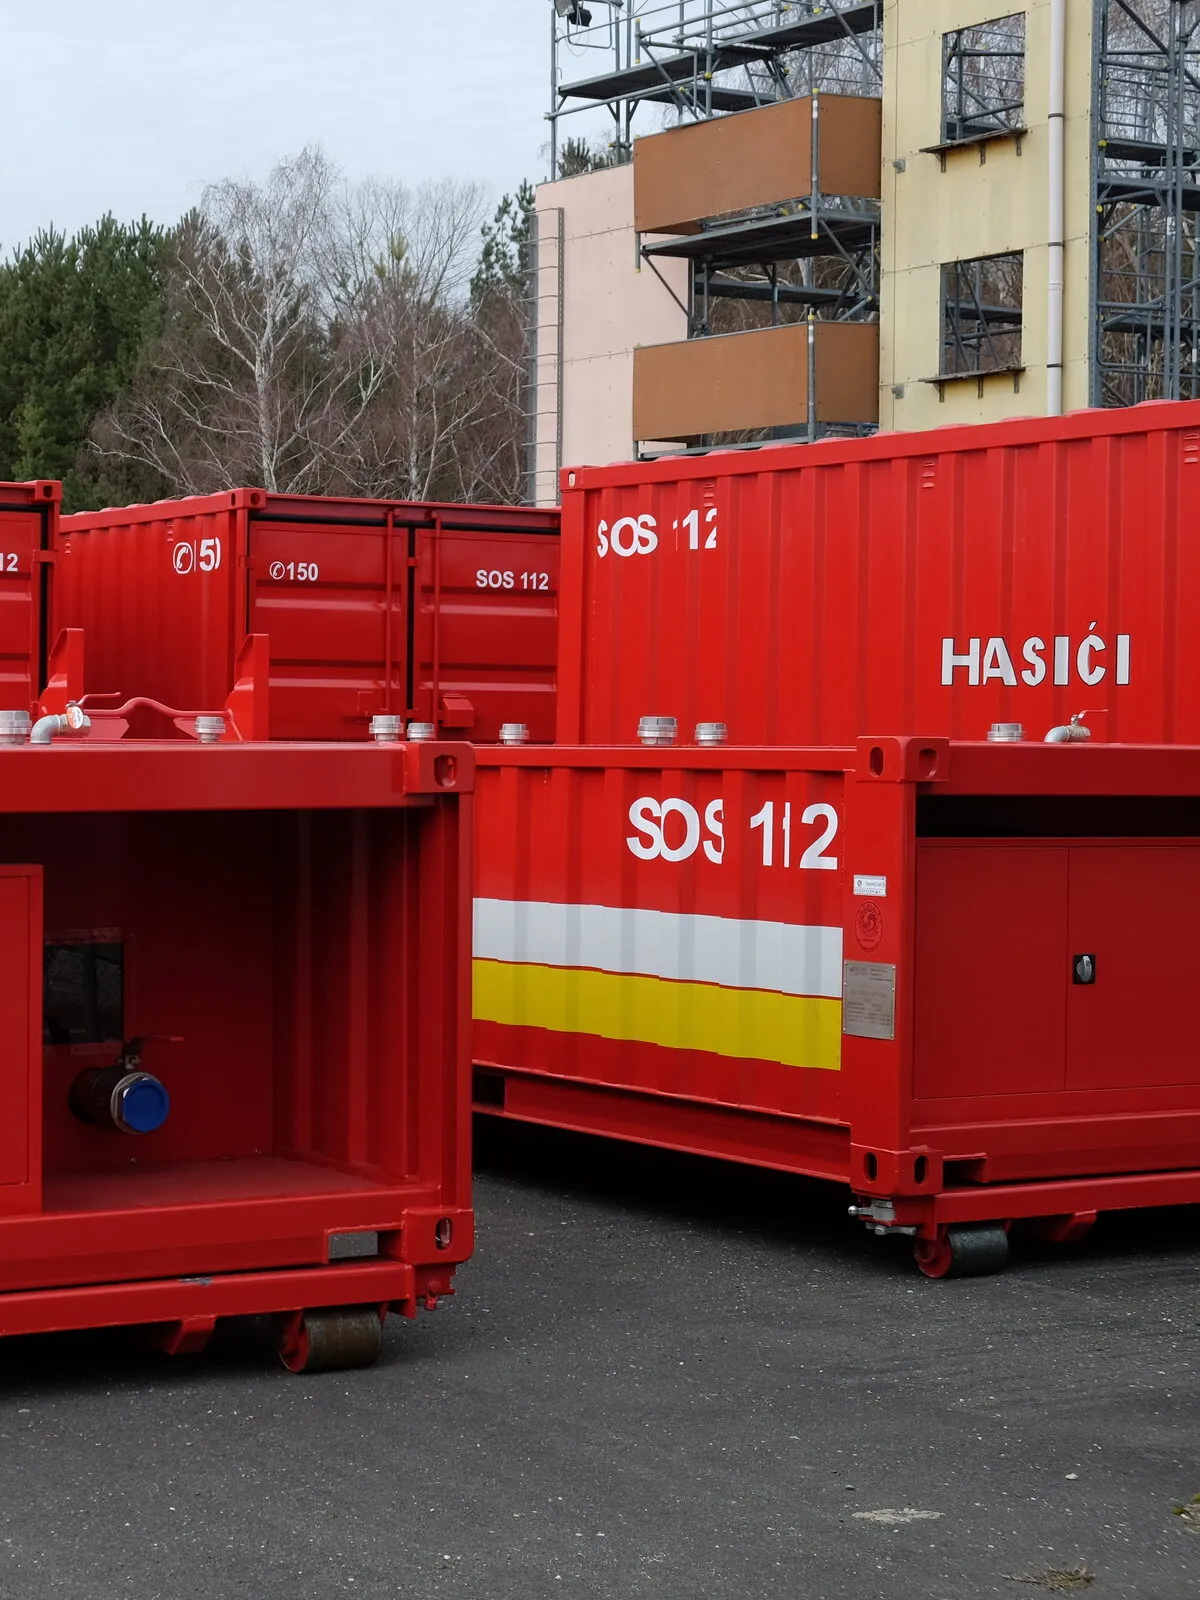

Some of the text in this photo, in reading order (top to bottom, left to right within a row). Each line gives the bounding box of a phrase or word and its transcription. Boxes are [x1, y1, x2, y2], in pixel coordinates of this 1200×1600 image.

[597, 513, 658, 558] SOS
[286, 562, 319, 581] 150
[476, 569, 549, 590] SOS 112
[626, 796, 725, 865] SOS
